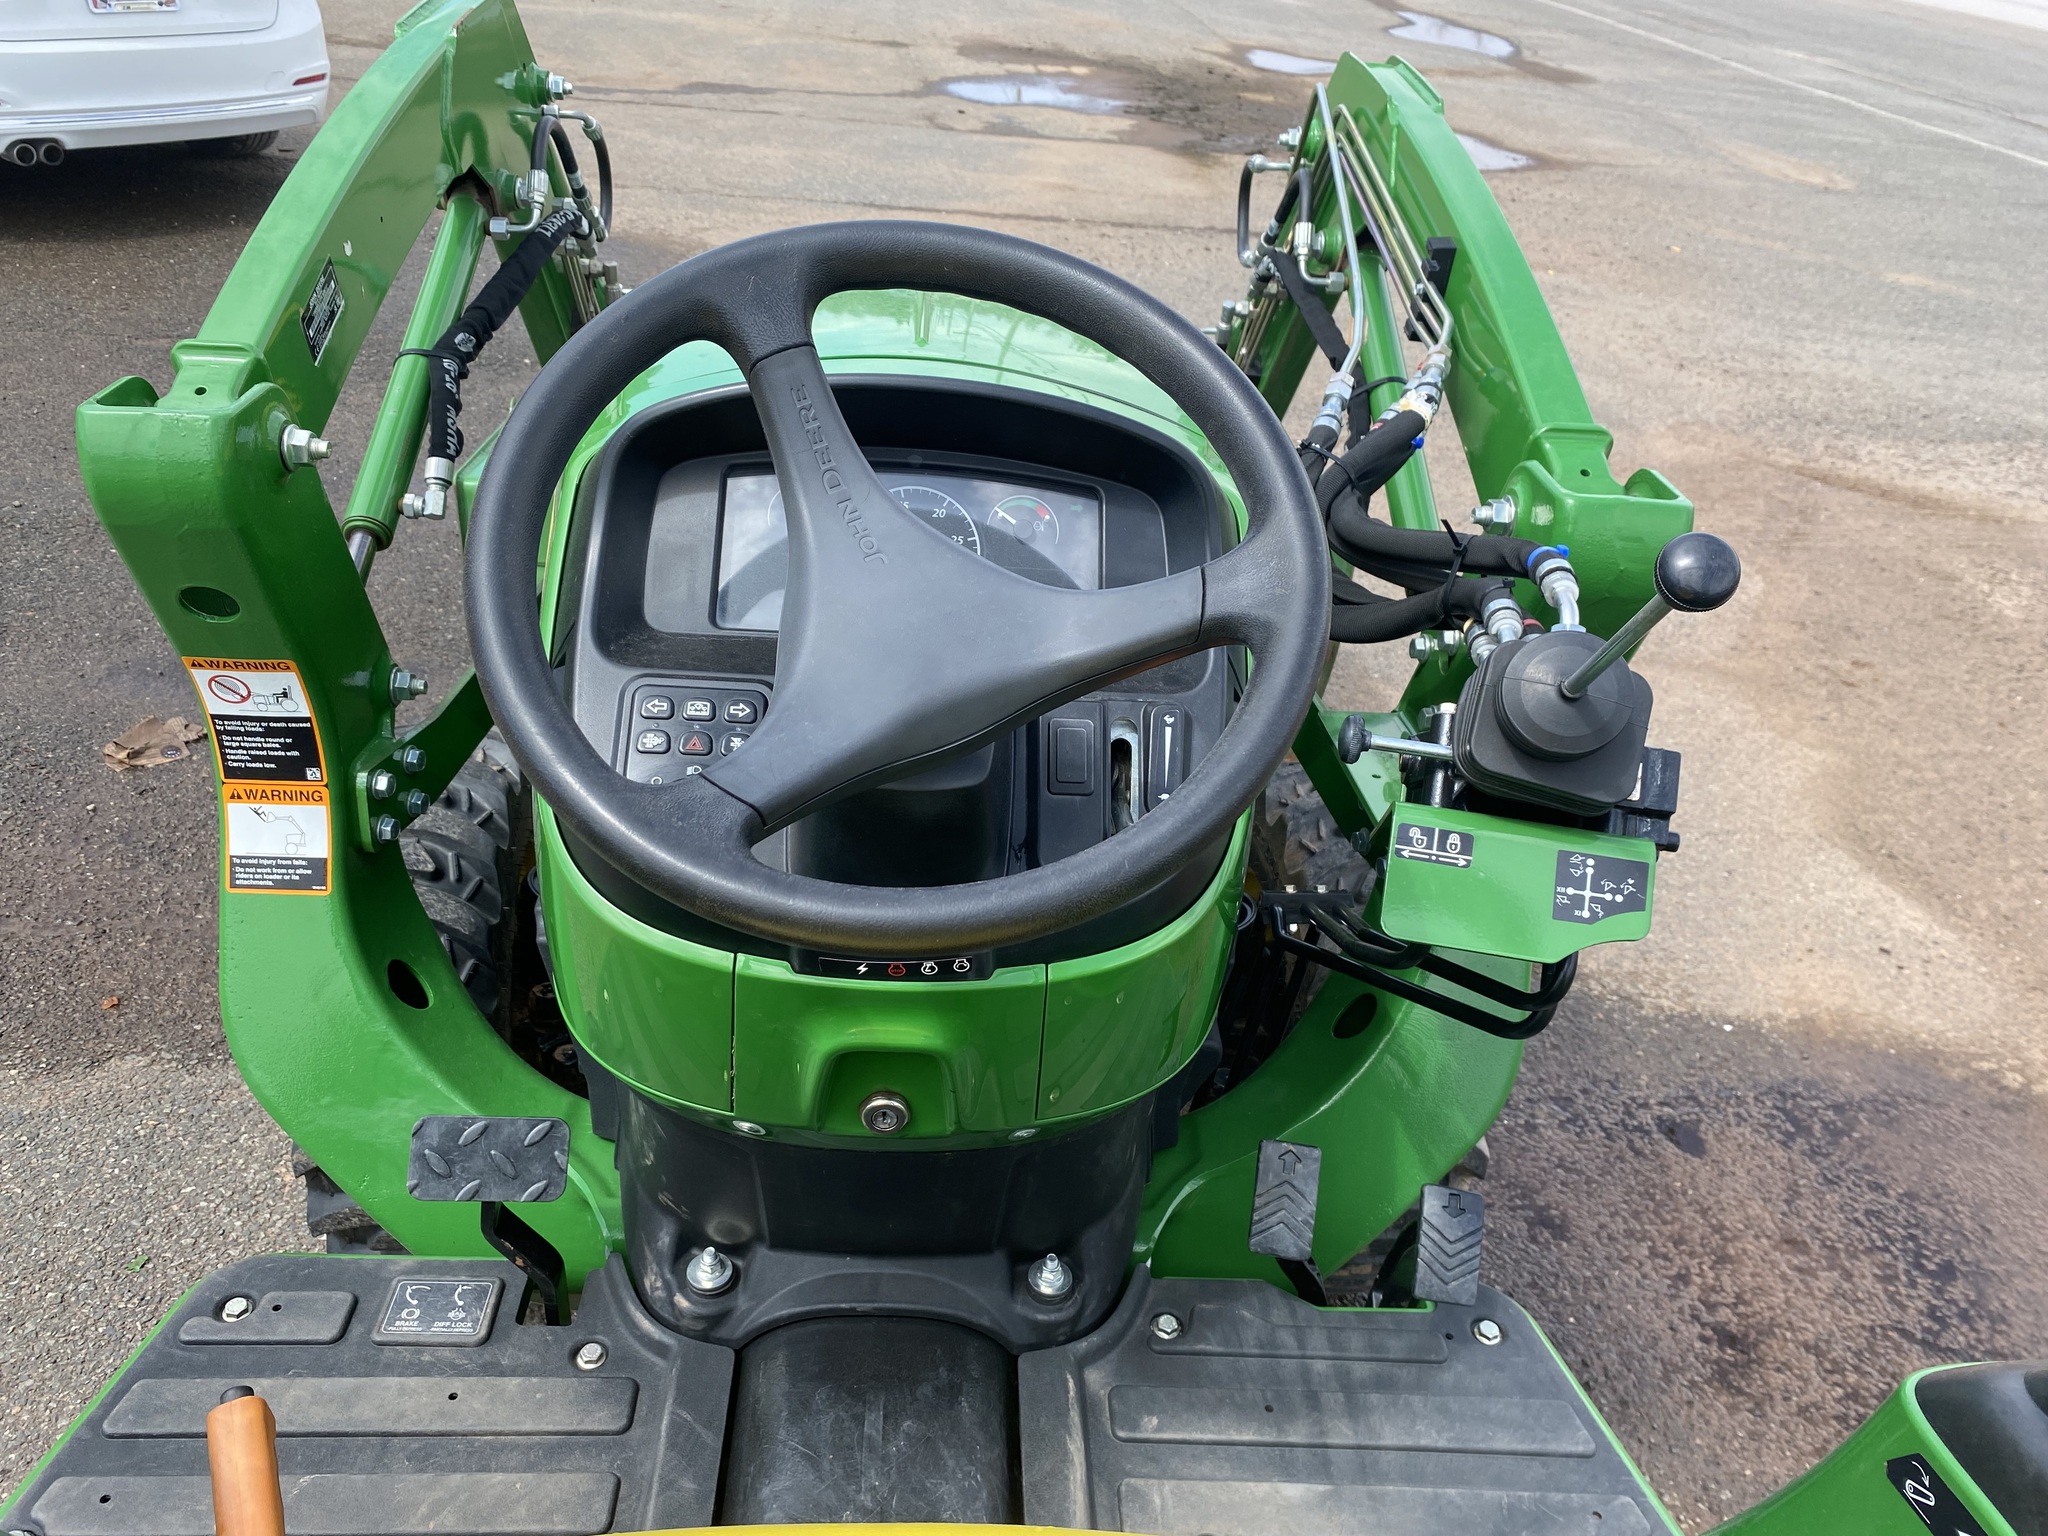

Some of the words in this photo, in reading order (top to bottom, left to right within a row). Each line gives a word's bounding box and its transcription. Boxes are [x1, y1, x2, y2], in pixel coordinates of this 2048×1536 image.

[790, 383, 847, 495] DEERE
[931, 508, 946, 518] 20
[837, 497, 889, 565] JOHN
[203, 659, 291, 671] WARNING
[243, 788, 323, 802] WARNING
[259, 858, 276, 866] injury
